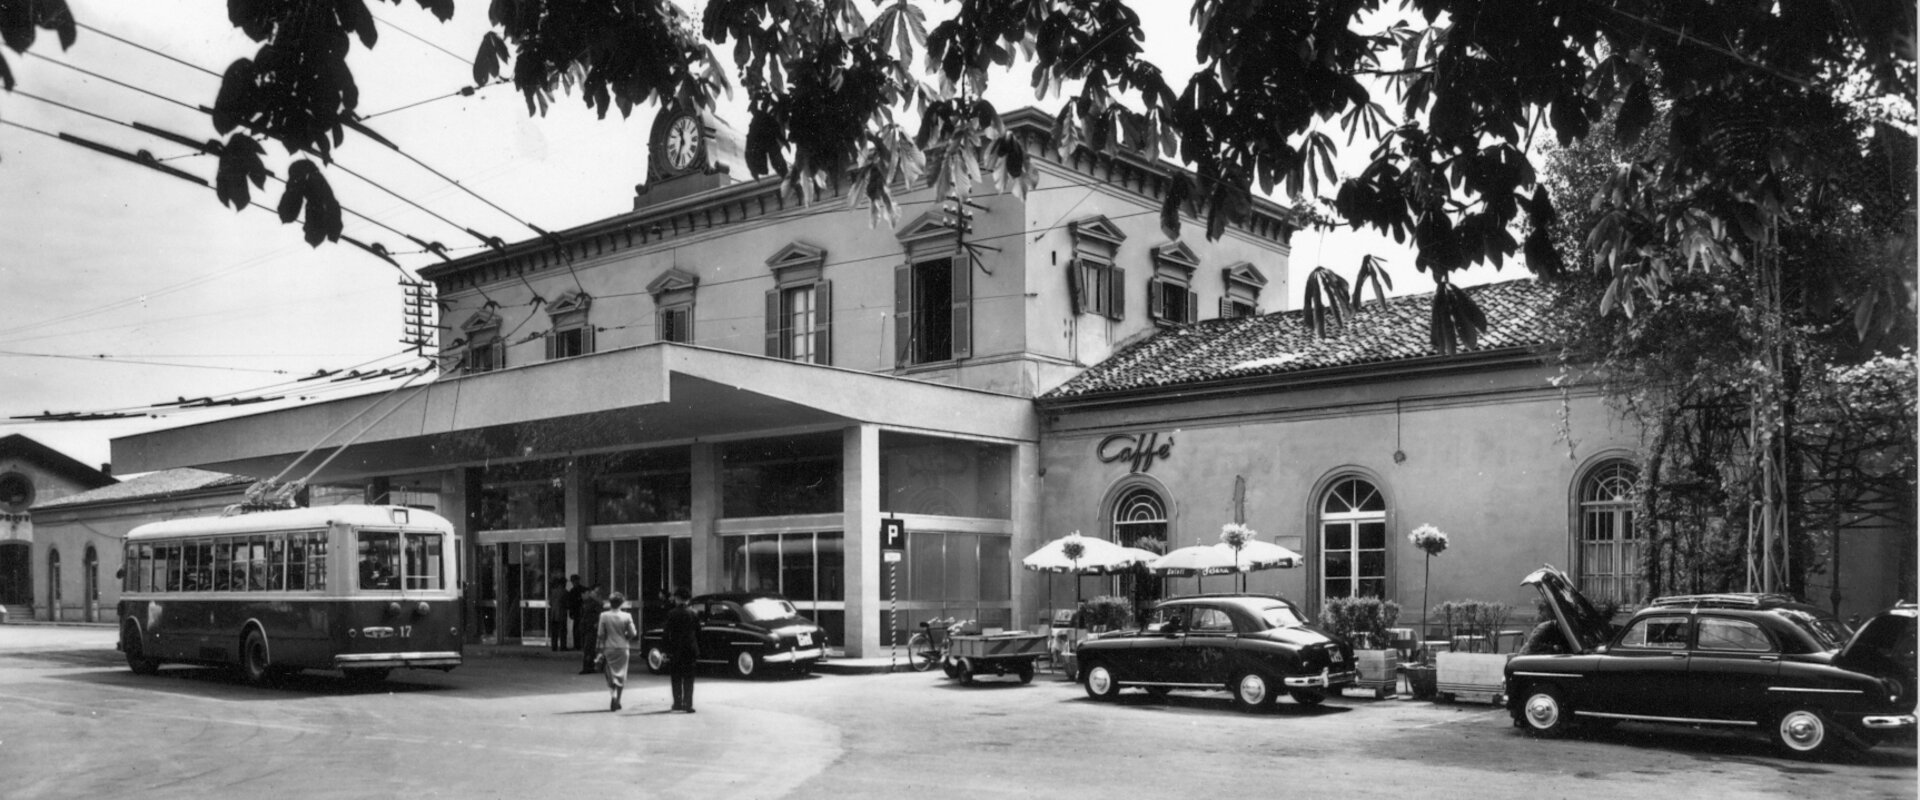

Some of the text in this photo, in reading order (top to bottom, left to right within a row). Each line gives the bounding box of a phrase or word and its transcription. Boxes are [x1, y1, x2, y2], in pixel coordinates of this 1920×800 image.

[1096, 432, 1175, 473] Caffè
[888, 524, 899, 546] P
[399, 625, 412, 638] 17
